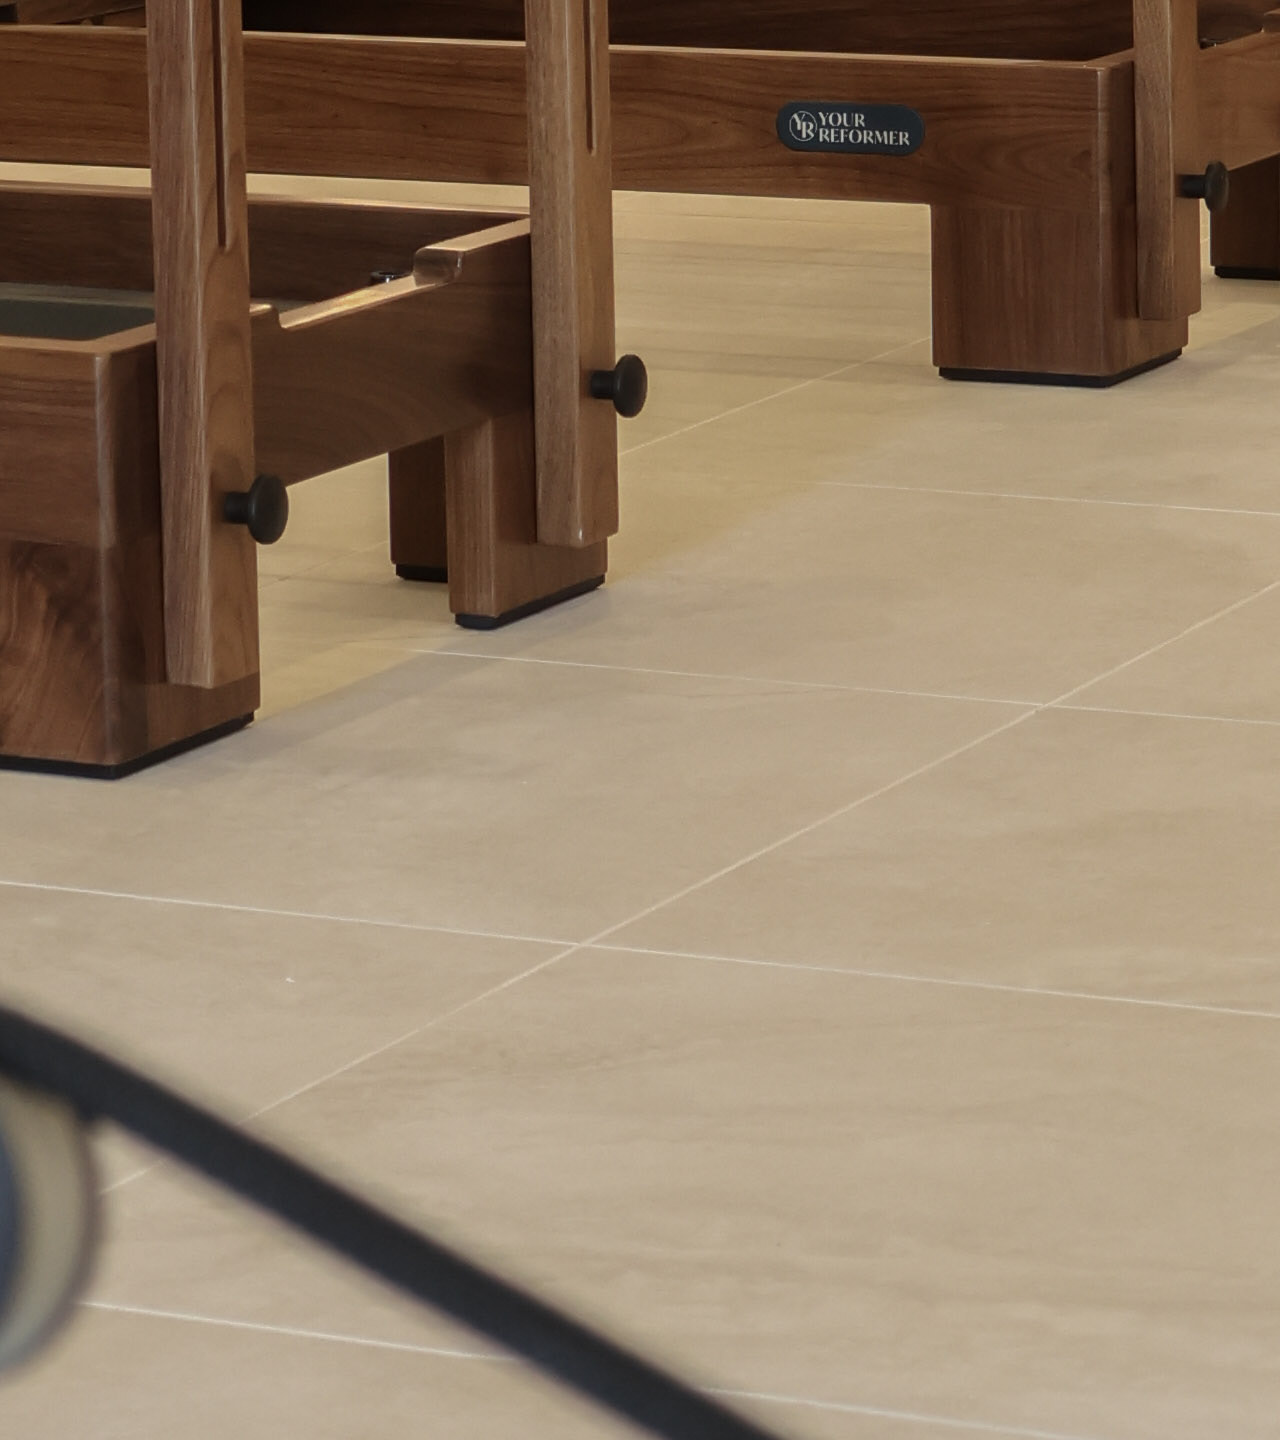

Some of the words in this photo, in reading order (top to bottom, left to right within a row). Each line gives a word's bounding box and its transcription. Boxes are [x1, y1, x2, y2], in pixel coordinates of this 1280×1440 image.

[792, 112, 816, 140] YR
[818, 112, 865, 128] YOUR
[819, 128, 910, 146] REFORMER
